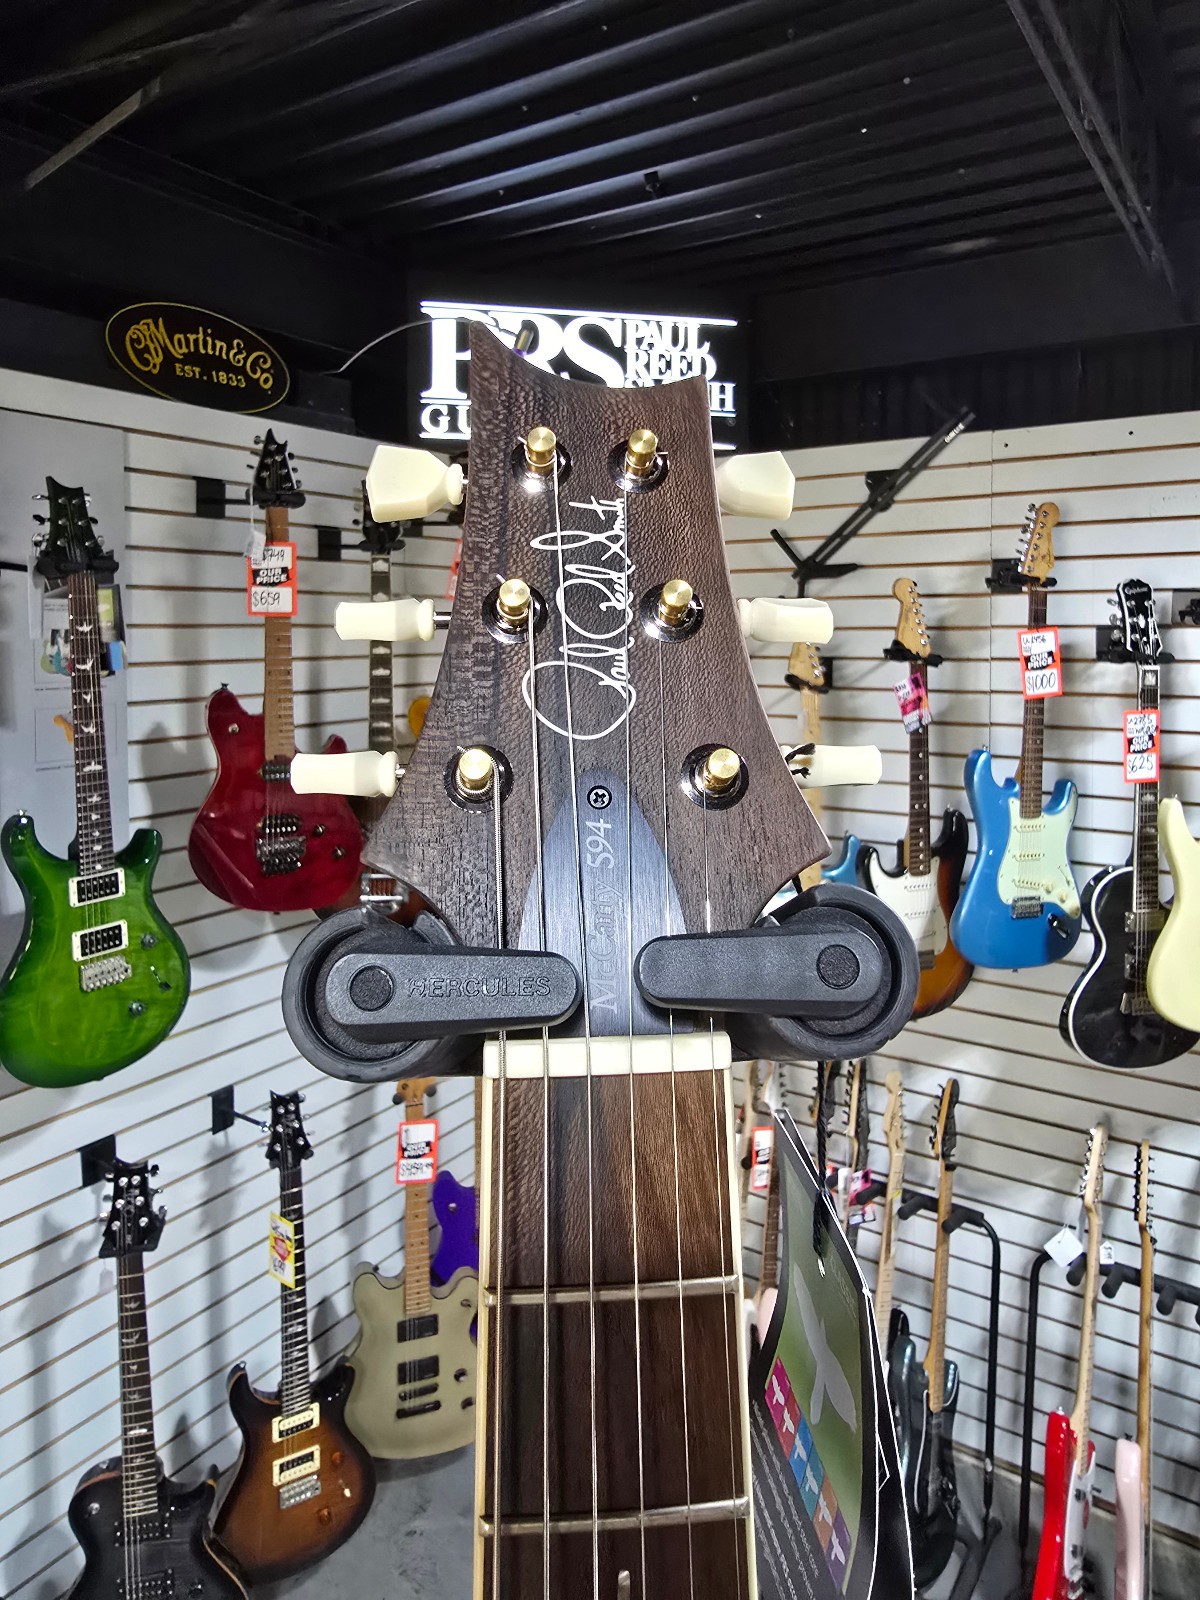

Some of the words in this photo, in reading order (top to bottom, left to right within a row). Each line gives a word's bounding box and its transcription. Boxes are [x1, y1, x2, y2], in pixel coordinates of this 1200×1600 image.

[624, 319, 711, 351] PAUL
[624, 349, 717, 380] REED
[211, 370, 247, 388] 1833
[256, 573, 288, 585] PRICE
[259, 567, 282, 577] OUR
[252, 591, 280, 608] $659
[1027, 656, 1053, 670] PRICE
[1030, 652, 1049, 661] OUR
[1027, 671, 1056, 693] $1000
[1128, 755, 1154, 774] $625
[585, 818, 615, 869] 594
[587, 881, 624, 1014] McCarty
[407, 976, 551, 998] HERCULES
